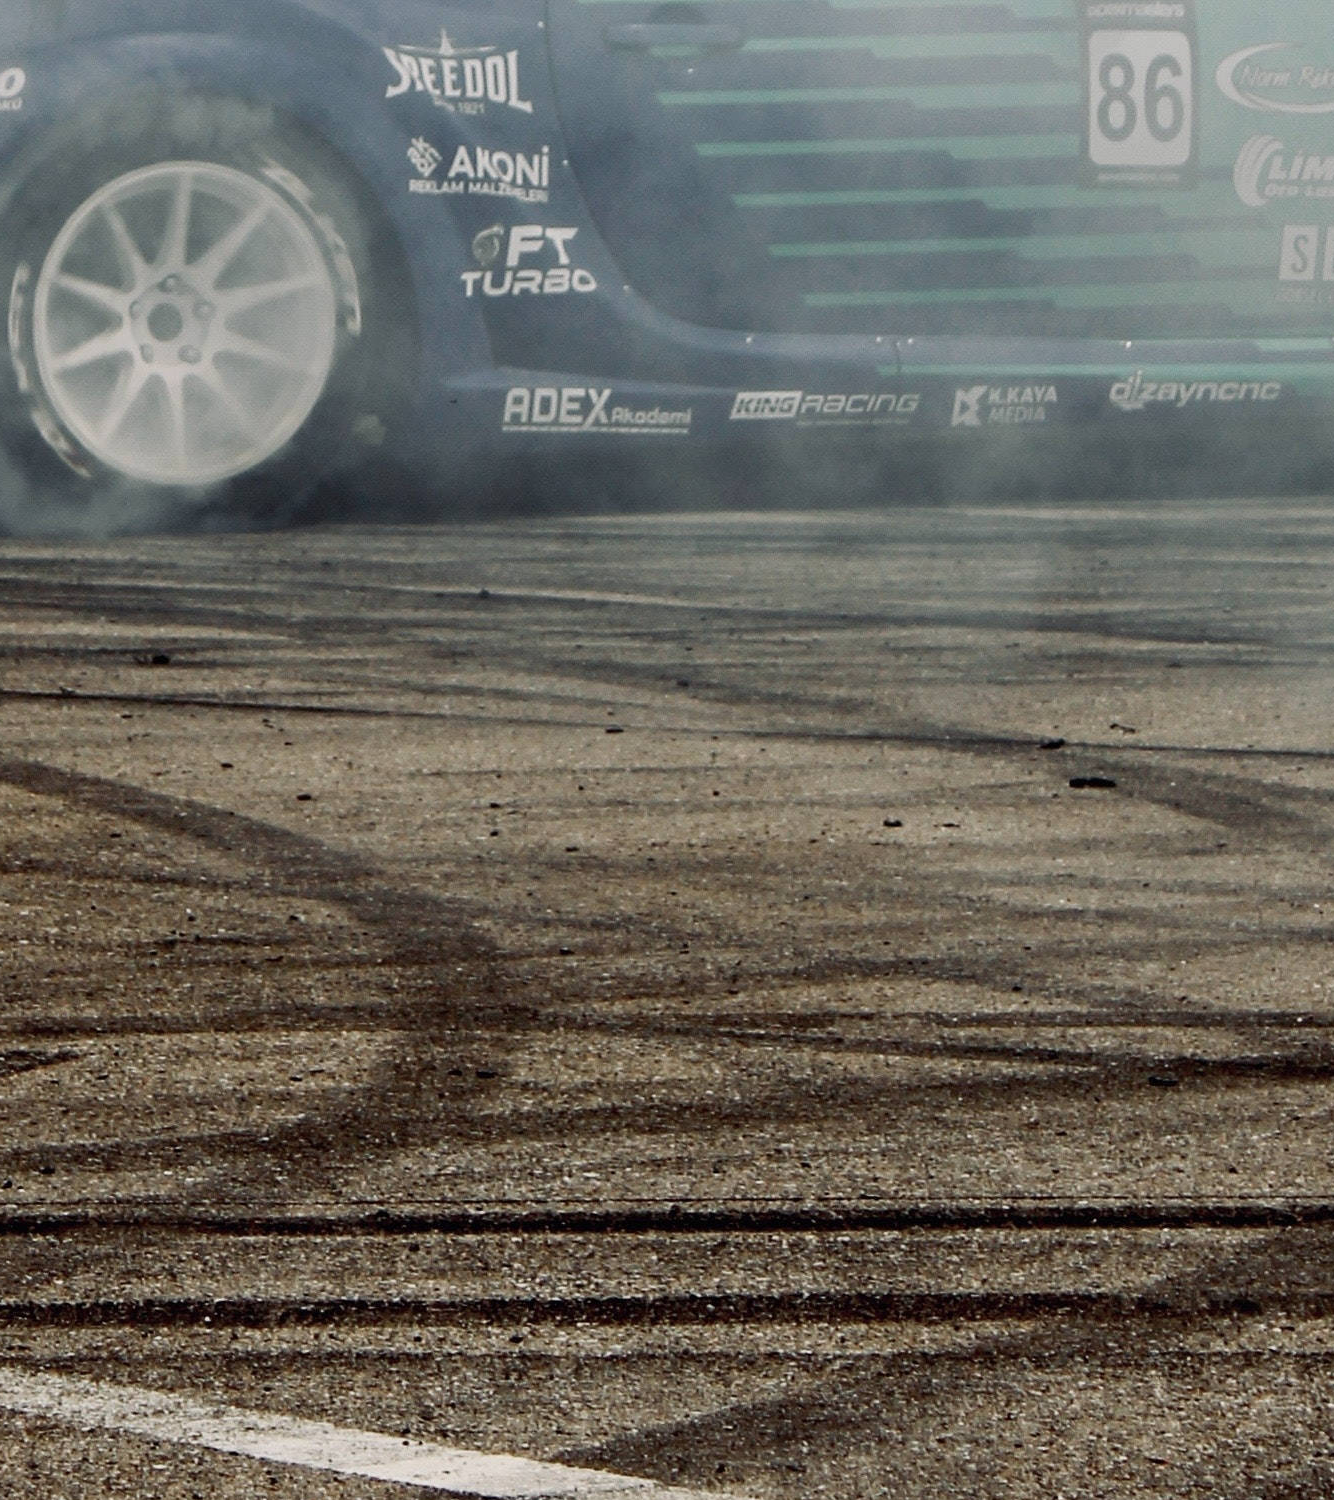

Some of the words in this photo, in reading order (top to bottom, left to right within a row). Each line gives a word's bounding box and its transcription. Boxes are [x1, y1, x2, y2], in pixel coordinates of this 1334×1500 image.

[382, 46, 534, 114] SPEEDOL
[1097, 53, 1185, 142] 86
[506, 225, 580, 267] FT
[460, 268, 598, 298] TURBO
[503, 387, 612, 429] ADEX
